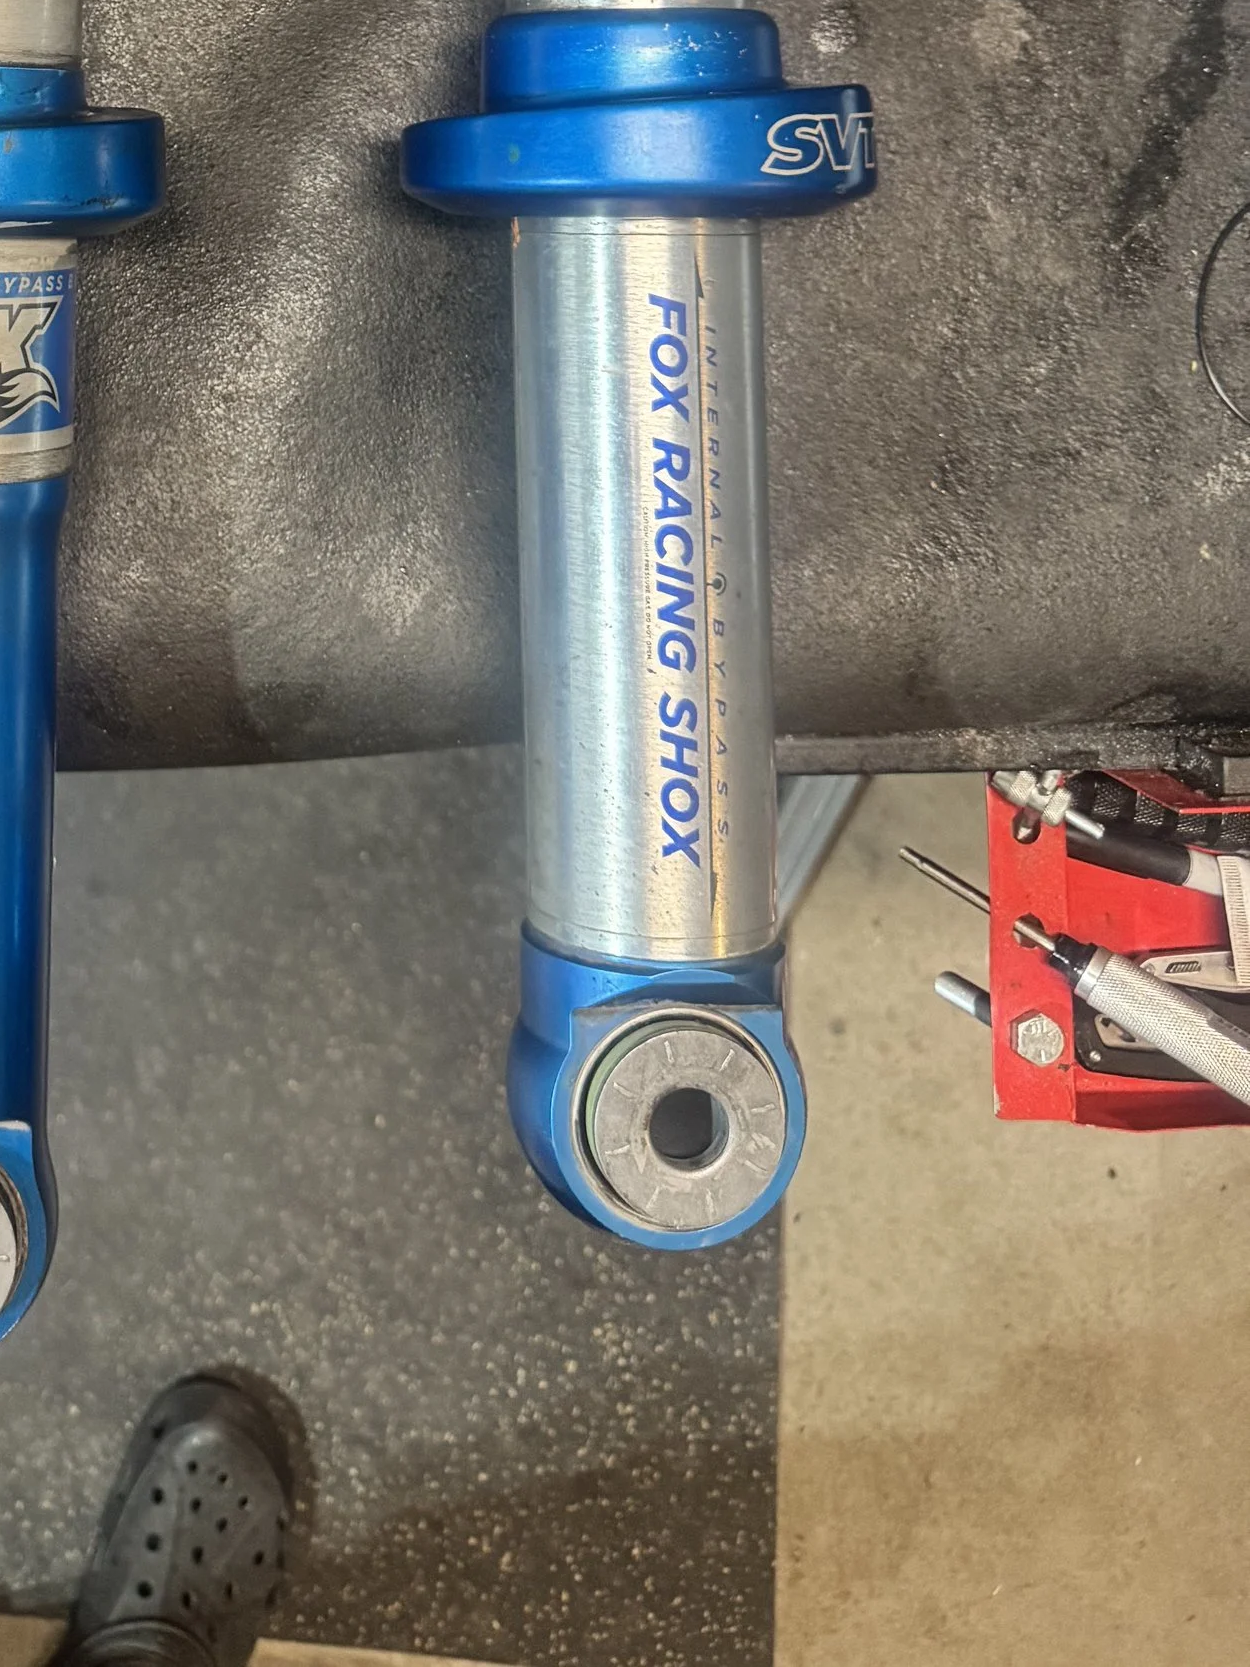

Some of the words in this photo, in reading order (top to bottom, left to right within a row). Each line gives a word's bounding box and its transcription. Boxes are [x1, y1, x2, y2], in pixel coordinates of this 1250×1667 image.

[648, 293, 689, 423] FOX
[704, 325, 724, 549] INTERNAL
[653, 438, 697, 674] RACING
[659, 695, 701, 869] SHOX
[712, 618, 731, 837] BYPASS
